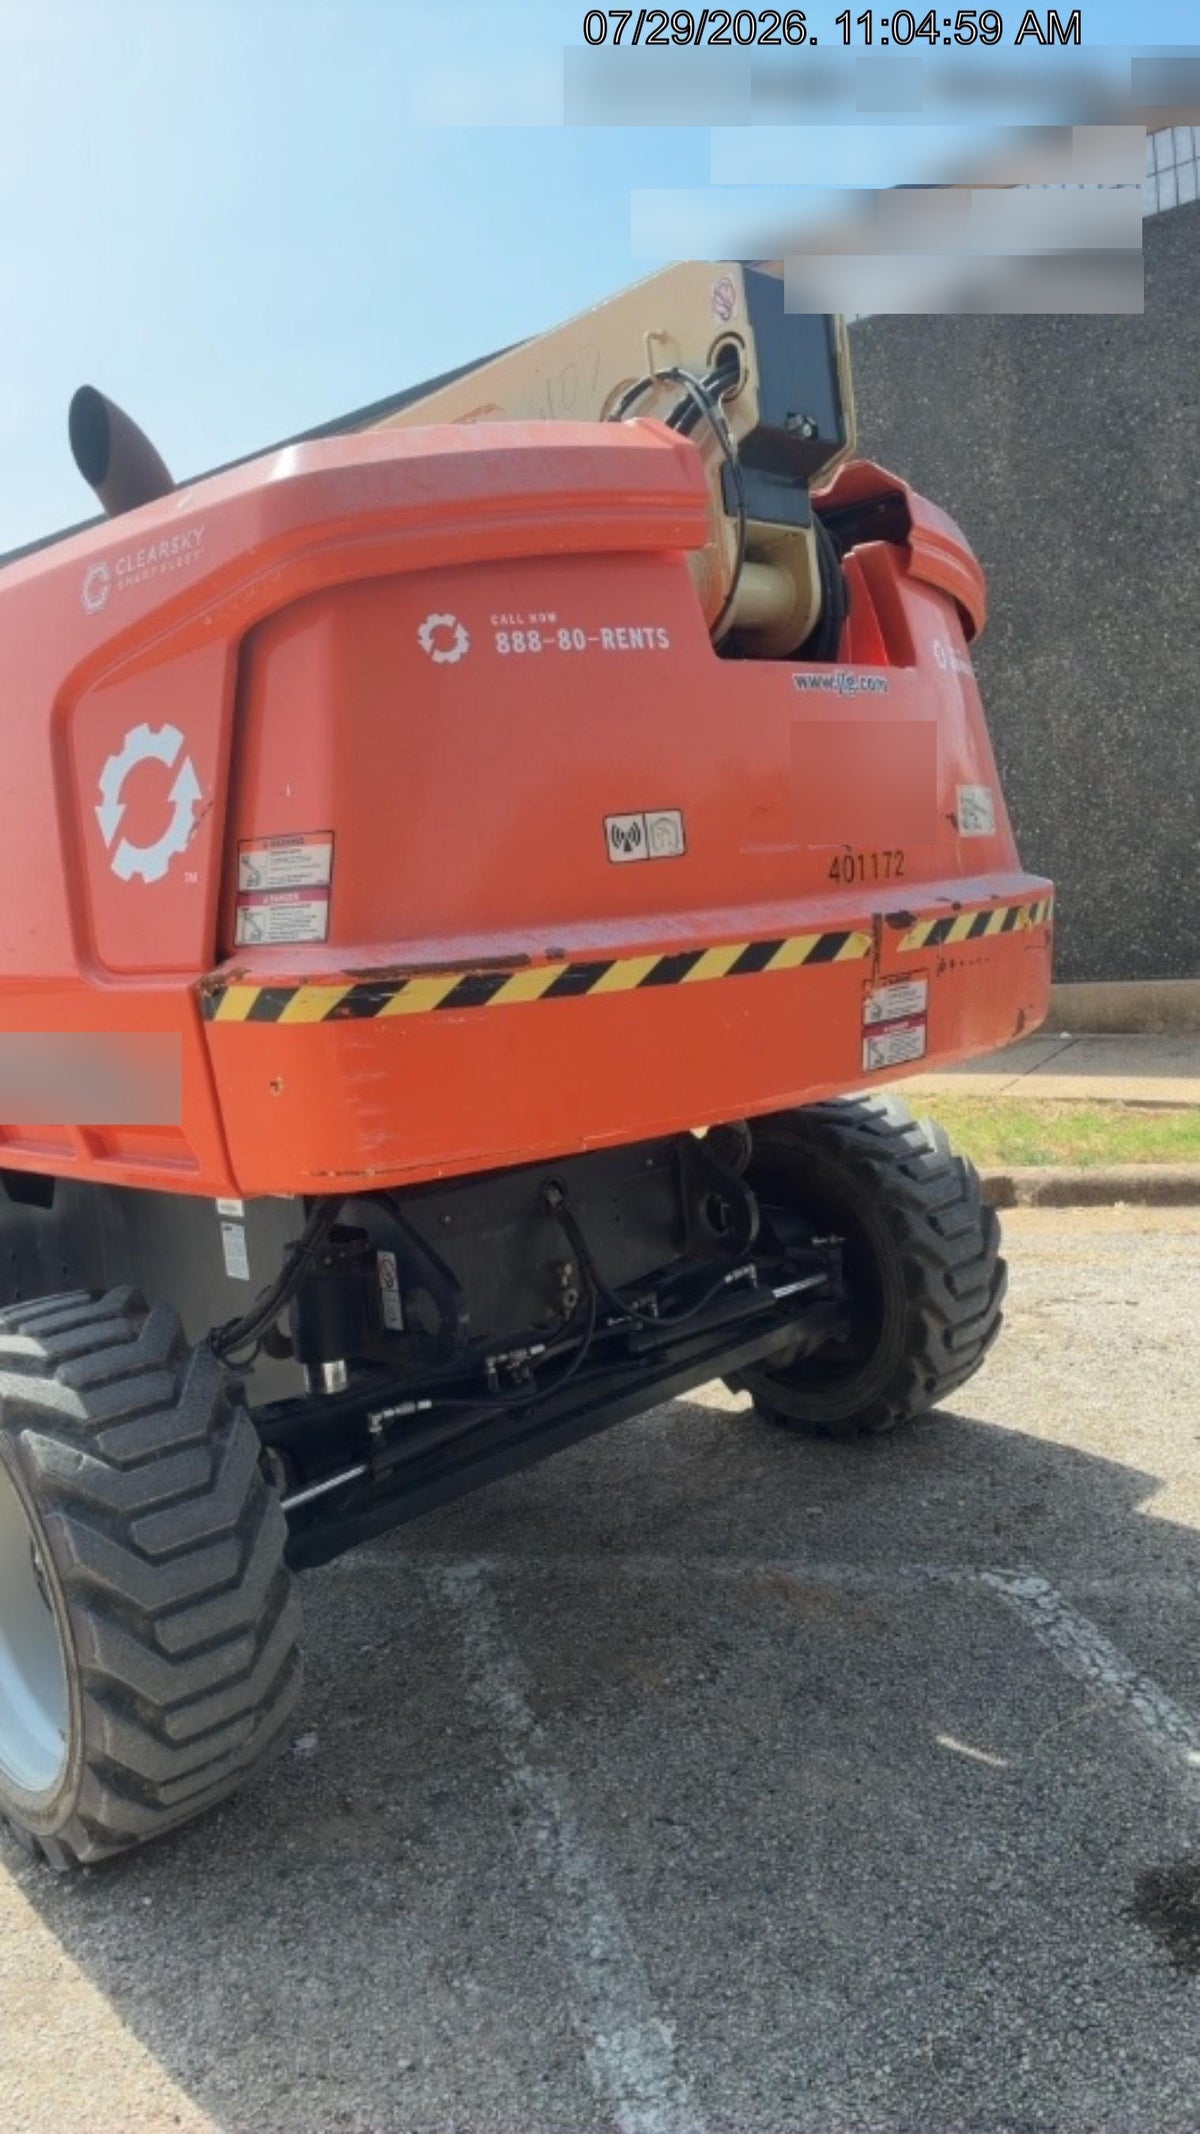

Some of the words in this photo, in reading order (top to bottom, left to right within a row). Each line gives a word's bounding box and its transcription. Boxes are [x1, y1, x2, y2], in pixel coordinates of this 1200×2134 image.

[116, 525, 205, 575] CLEARSKY
[490, 613, 525, 626] CALL
[528, 611, 556, 624] NOW
[495, 627, 670, 654] 888-80-RENTS
[793, 672, 888, 696] www.jlg.com
[828, 850, 905, 884] 401172
